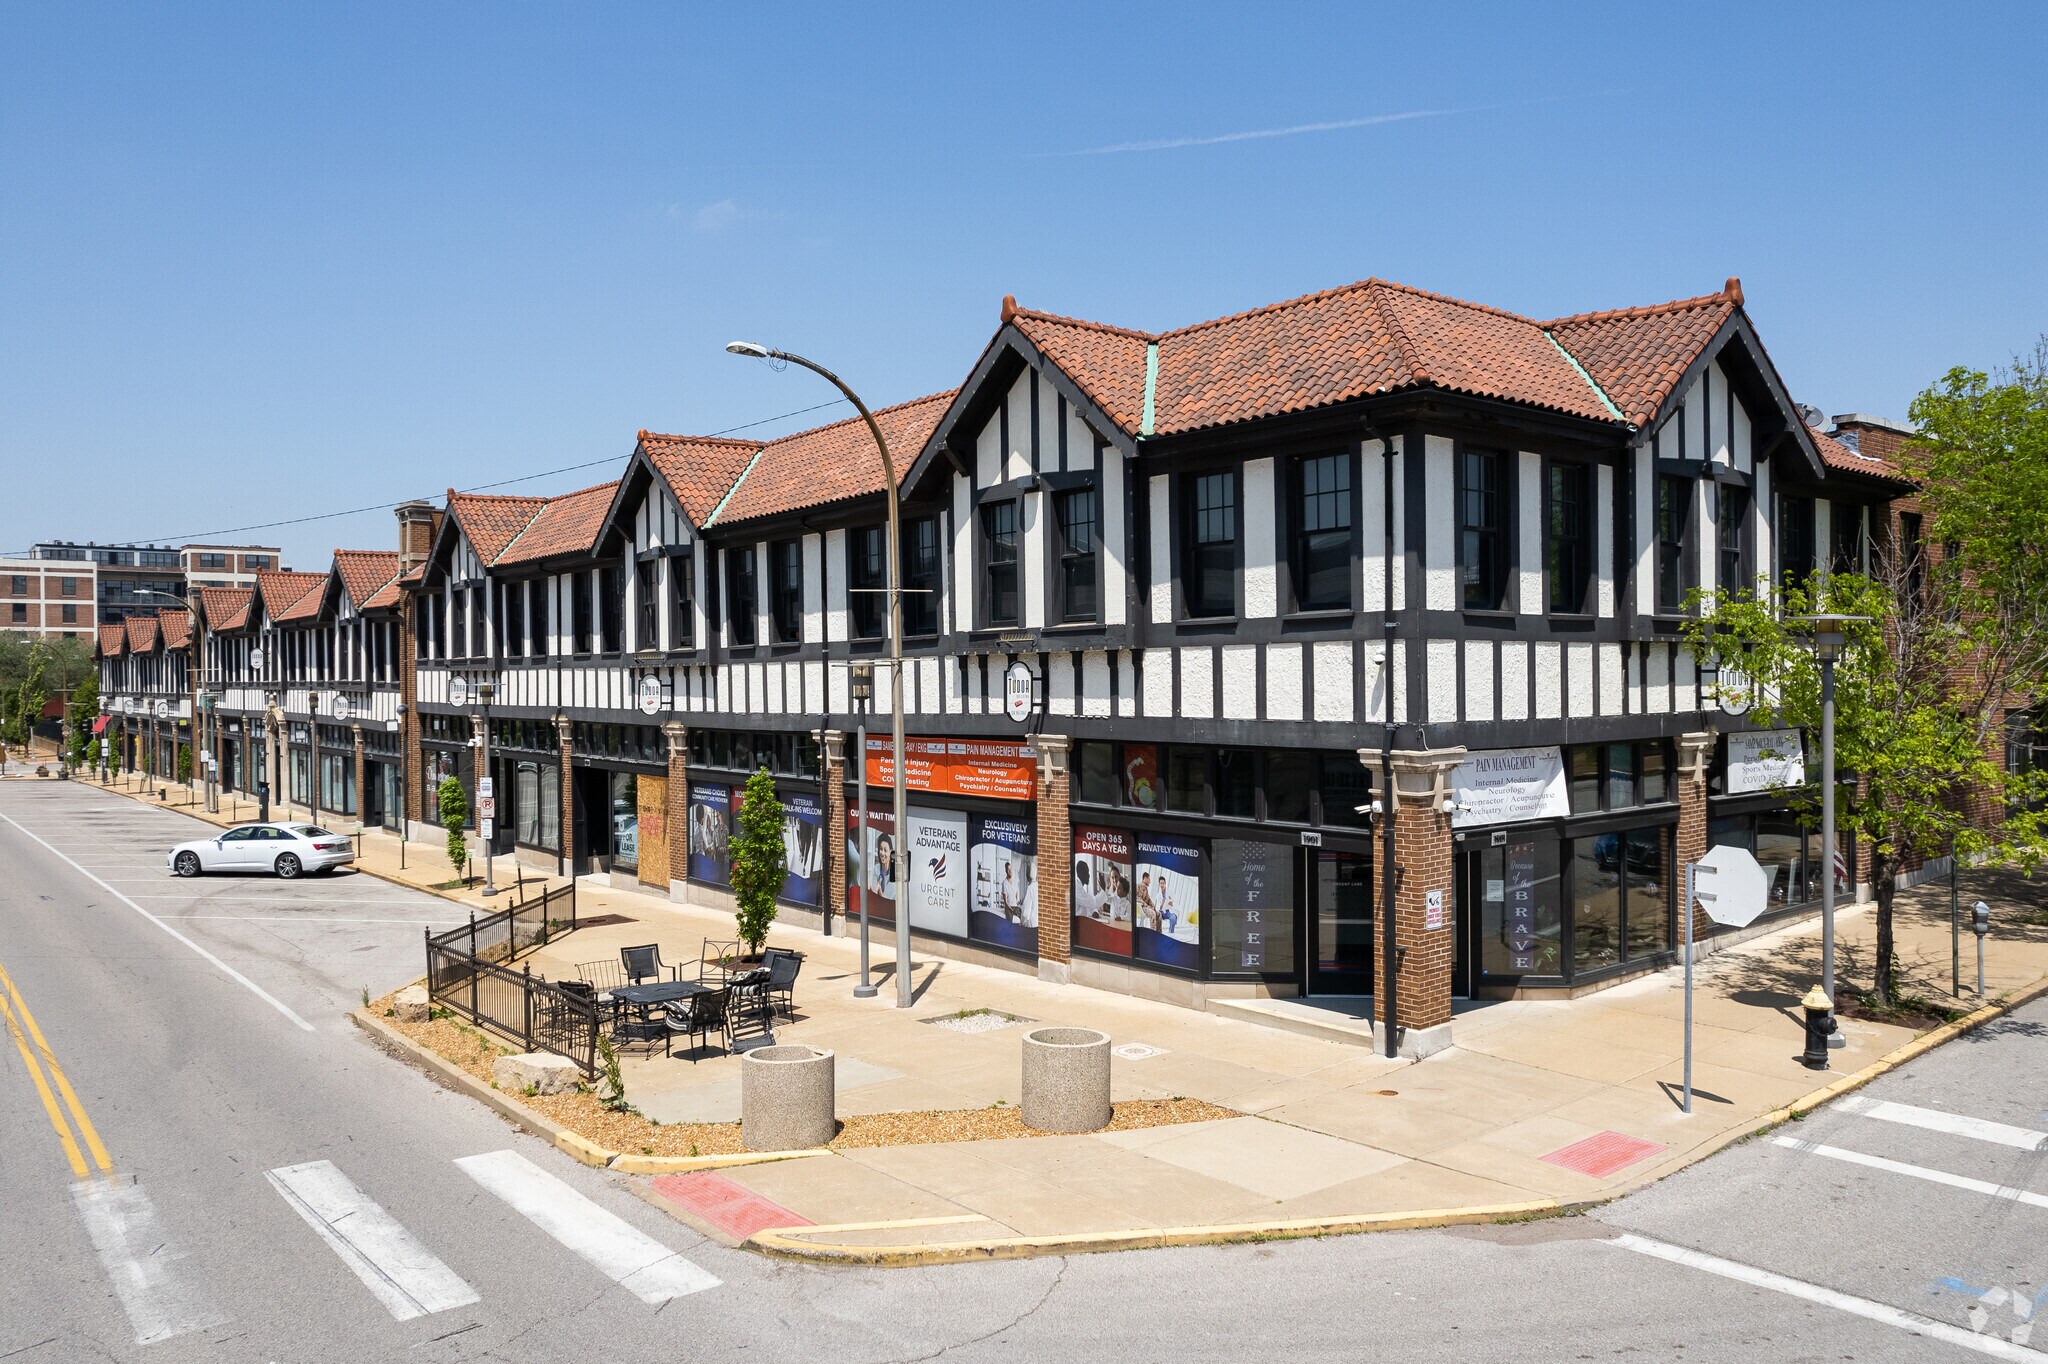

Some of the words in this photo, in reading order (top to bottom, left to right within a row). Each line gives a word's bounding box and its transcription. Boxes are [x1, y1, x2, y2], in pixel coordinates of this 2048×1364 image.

[1008, 678, 1030, 694] TUDOR
[904, 742, 915, 753] -RAY
[966, 744, 979, 755] PAIN
[980, 745, 1019, 757] MANAGEMENT
[910, 759, 930, 768] Injury
[1476, 758, 1492, 772] PAIN
[1492, 756, 1536, 772] MANAGEMENT
[978, 768, 1007, 776] Neurology
[906, 778, 930, 787] Testing
[955, 774, 990, 783] Chiropractor
[995, 778, 1033, 786] Acupuncture
[1475, 778, 1503, 787] Internal
[1506, 776, 1538, 785] Medicine
[960, 782, 990, 791] Psychiatry
[994, 786, 1028, 794] Counseling
[1488, 786, 1526, 795] Neurology
[792, 798, 813, 807] VETERAN
[802, 806, 822, 815] WELCOM
[869, 811, 884, 820] WAIT
[919, 826, 957, 840] VETERANS
[984, 820, 1028, 834] EXCLUSIVELY
[982, 830, 996, 840] FOR
[996, 831, 1030, 845] VETERANS
[1086, 832, 1107, 842] OPEN
[1108, 834, 1122, 844] 365
[916, 838, 960, 852] ADVANTAGE
[1082, 841, 1100, 852] DAYS
[1101, 844, 1108, 852] A
[1108, 844, 1128, 855] YEAR
[1138, 843, 1172, 854] PRIVATELY
[1172, 847, 1199, 858] OWNED
[1242, 860, 1265, 872] Home
[1245, 872, 1253, 885] of
[1512, 871, 1520, 884] of
[1520, 879, 1532, 888] the
[920, 883, 955, 898] URGENT
[928, 896, 950, 909] CARE
[1246, 890, 1261, 966] FREE
[1515, 890, 1529, 968] BRAVE
